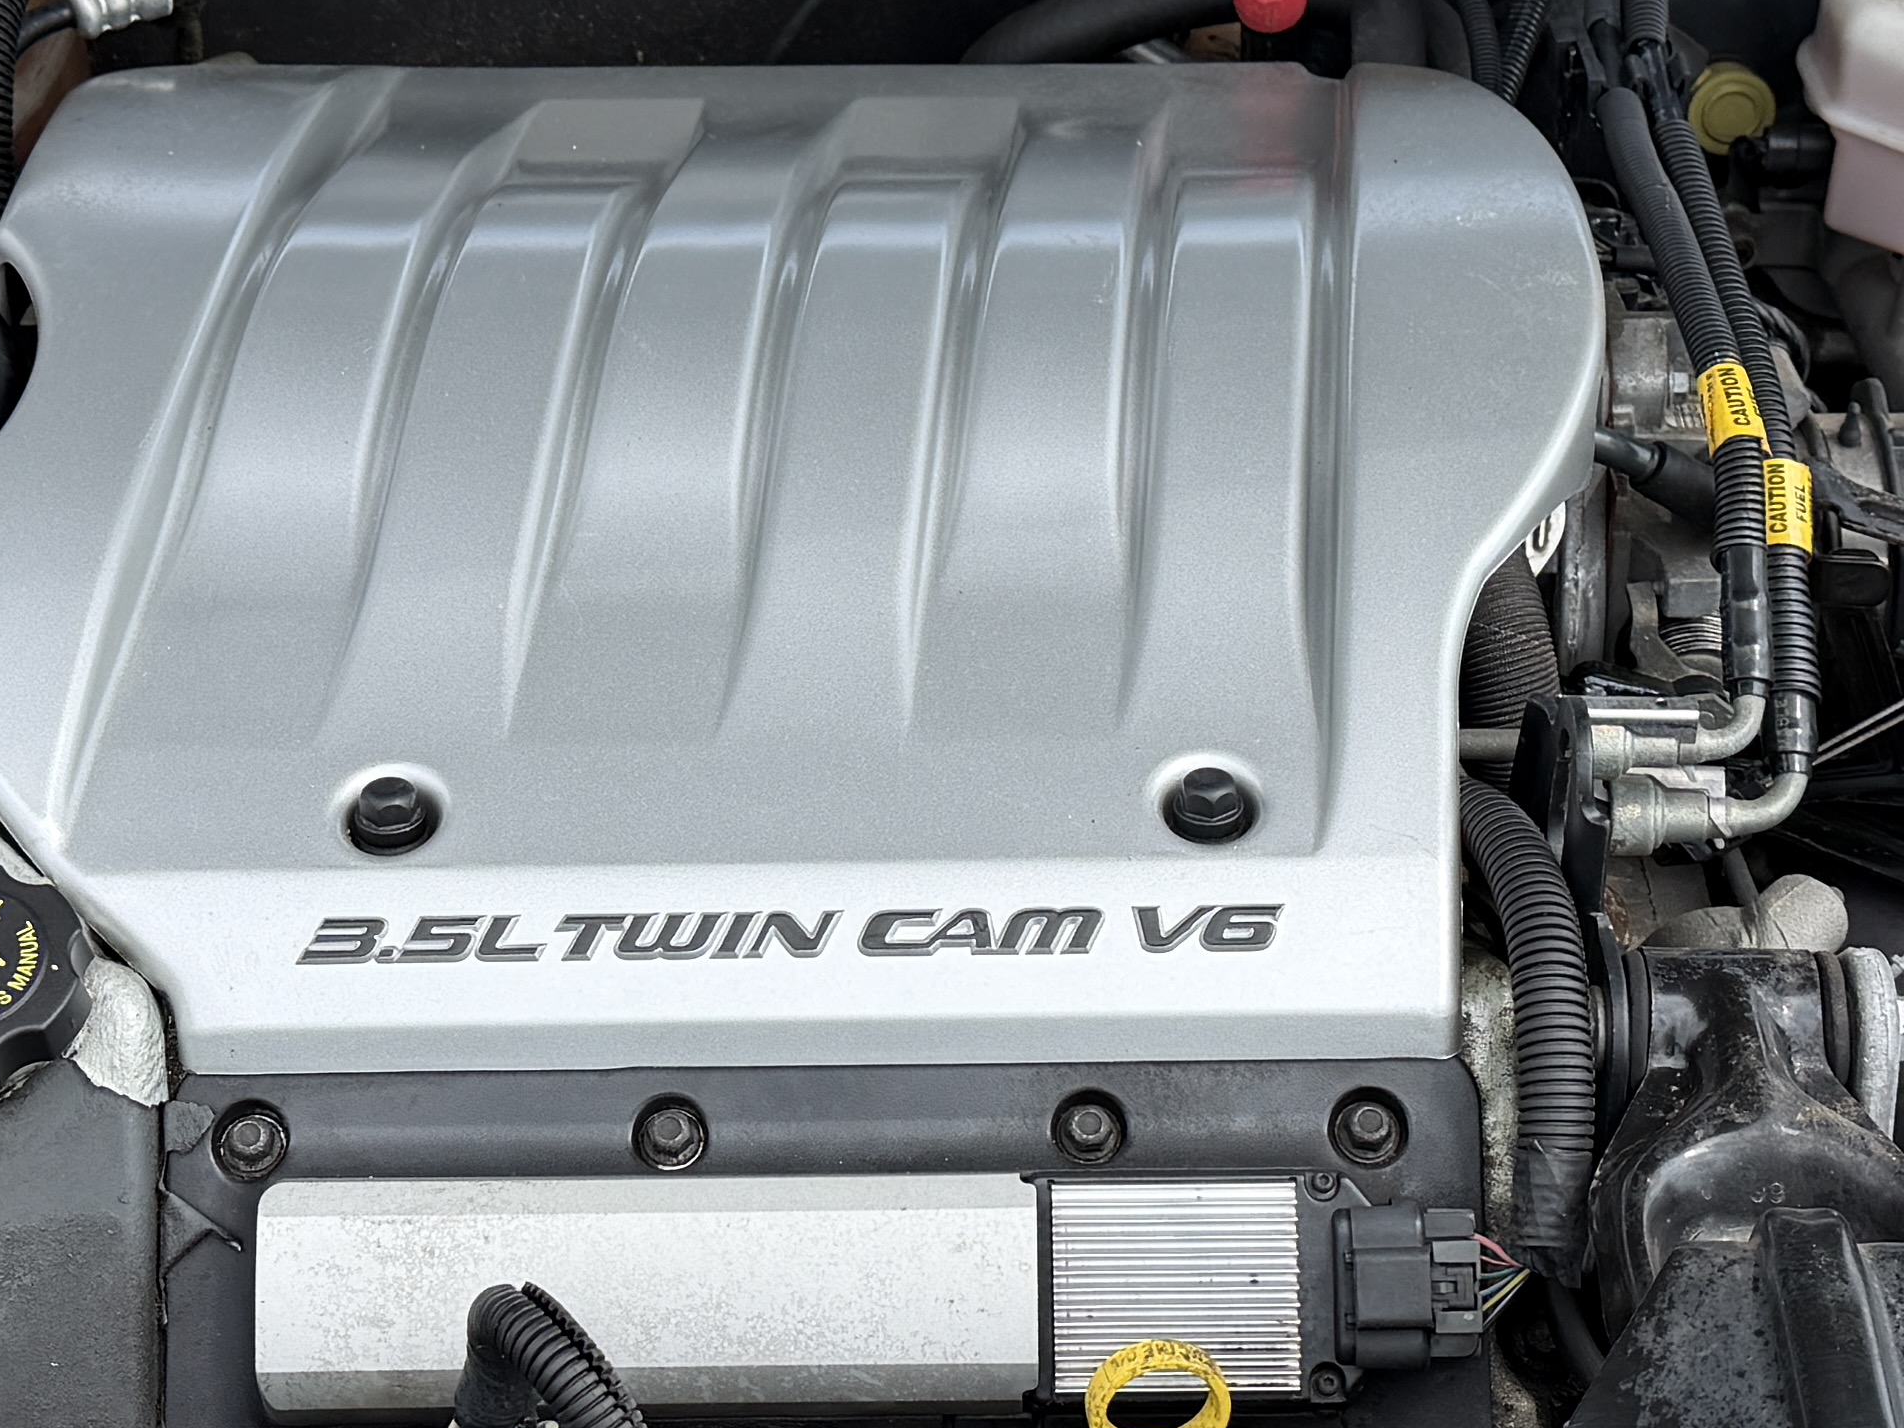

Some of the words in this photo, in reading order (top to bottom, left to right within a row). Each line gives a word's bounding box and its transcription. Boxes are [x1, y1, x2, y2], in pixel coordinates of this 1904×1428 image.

[1717, 367, 1751, 426] CAUTION
[1766, 463, 1788, 533] CAUTION
[1795, 484, 1807, 522] FUEL
[6, 920, 40, 992] MANUAL
[294, 912, 548, 967] 3.5L
[556, 908, 844, 962] TWIN
[854, 905, 1103, 957] CAM
[1130, 902, 1286, 954] V6
